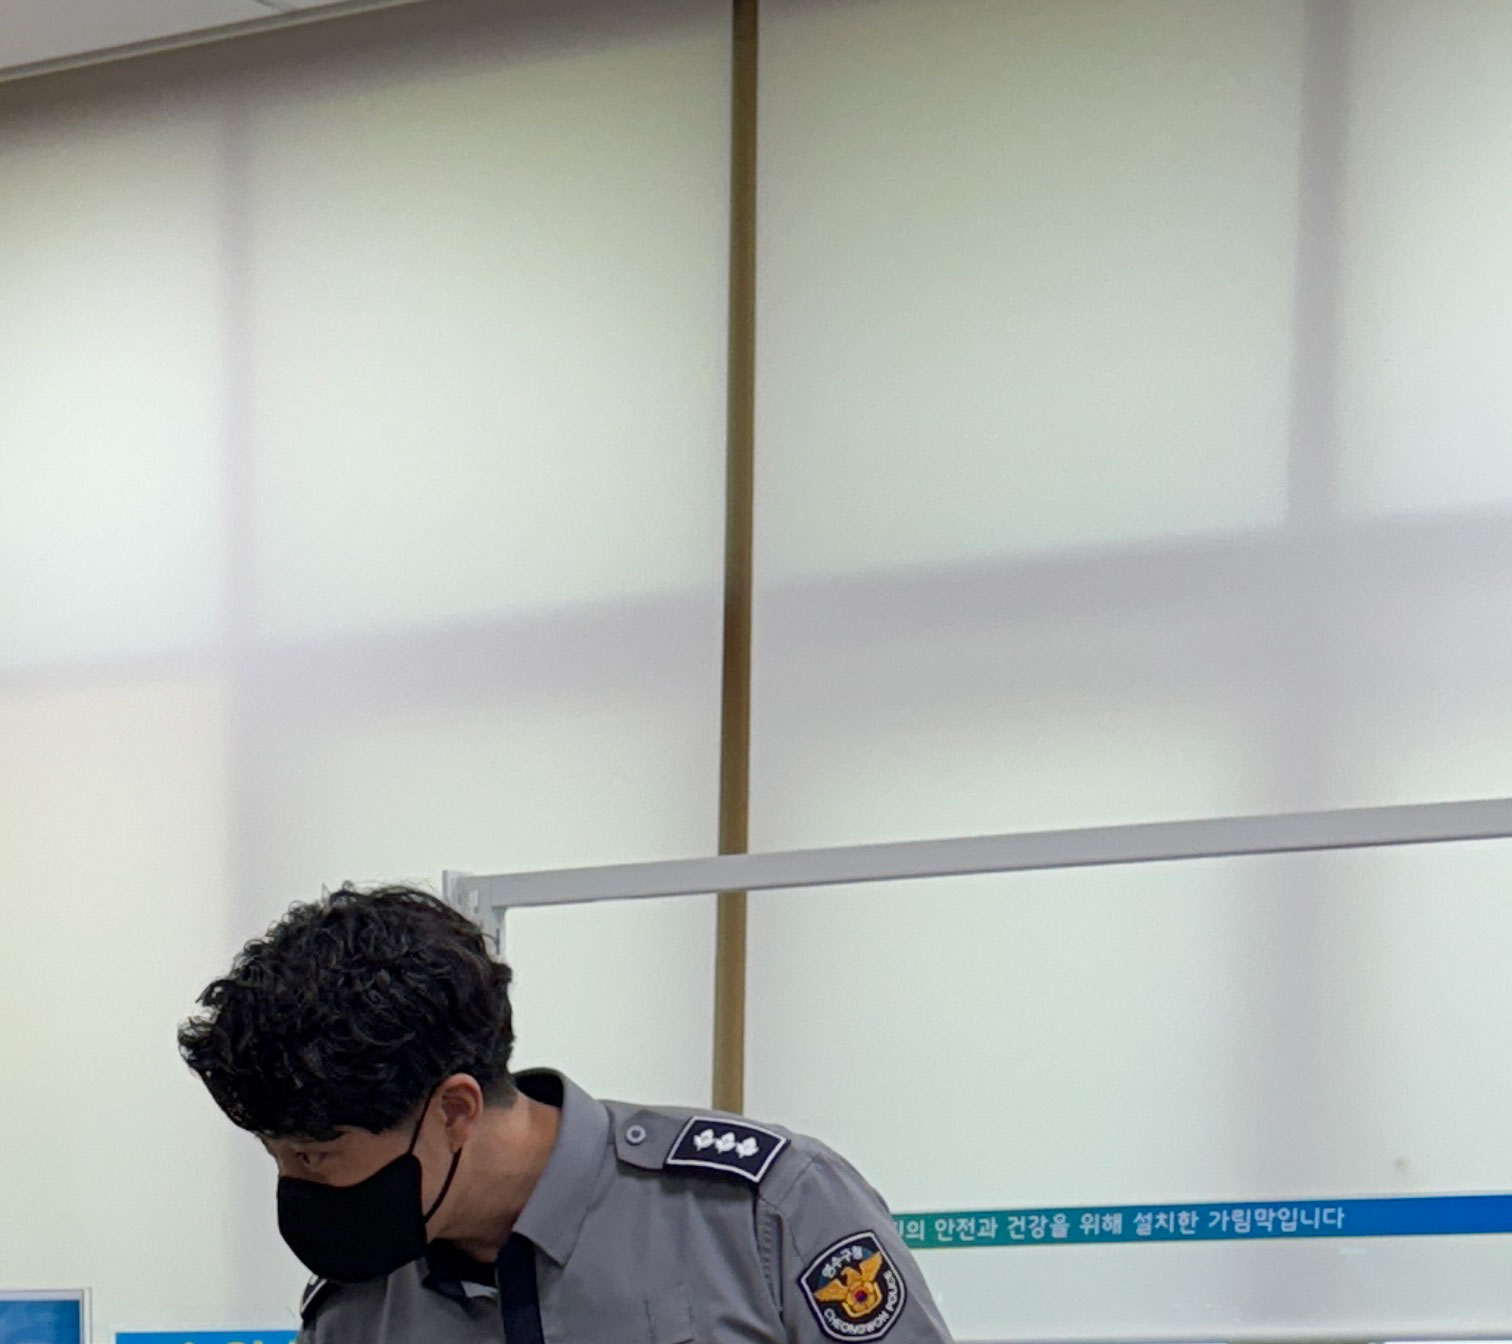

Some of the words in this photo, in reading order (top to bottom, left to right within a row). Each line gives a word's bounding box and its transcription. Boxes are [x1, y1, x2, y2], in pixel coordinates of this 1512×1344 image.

[935, 1218, 998, 1242] 안전과
[1007, 1215, 1071, 1240] 건강을
[1080, 1213, 1123, 1236] 위해
[1134, 1211, 1199, 1236] 설치한
[1208, 1206, 1346, 1232] 가림막입니다
